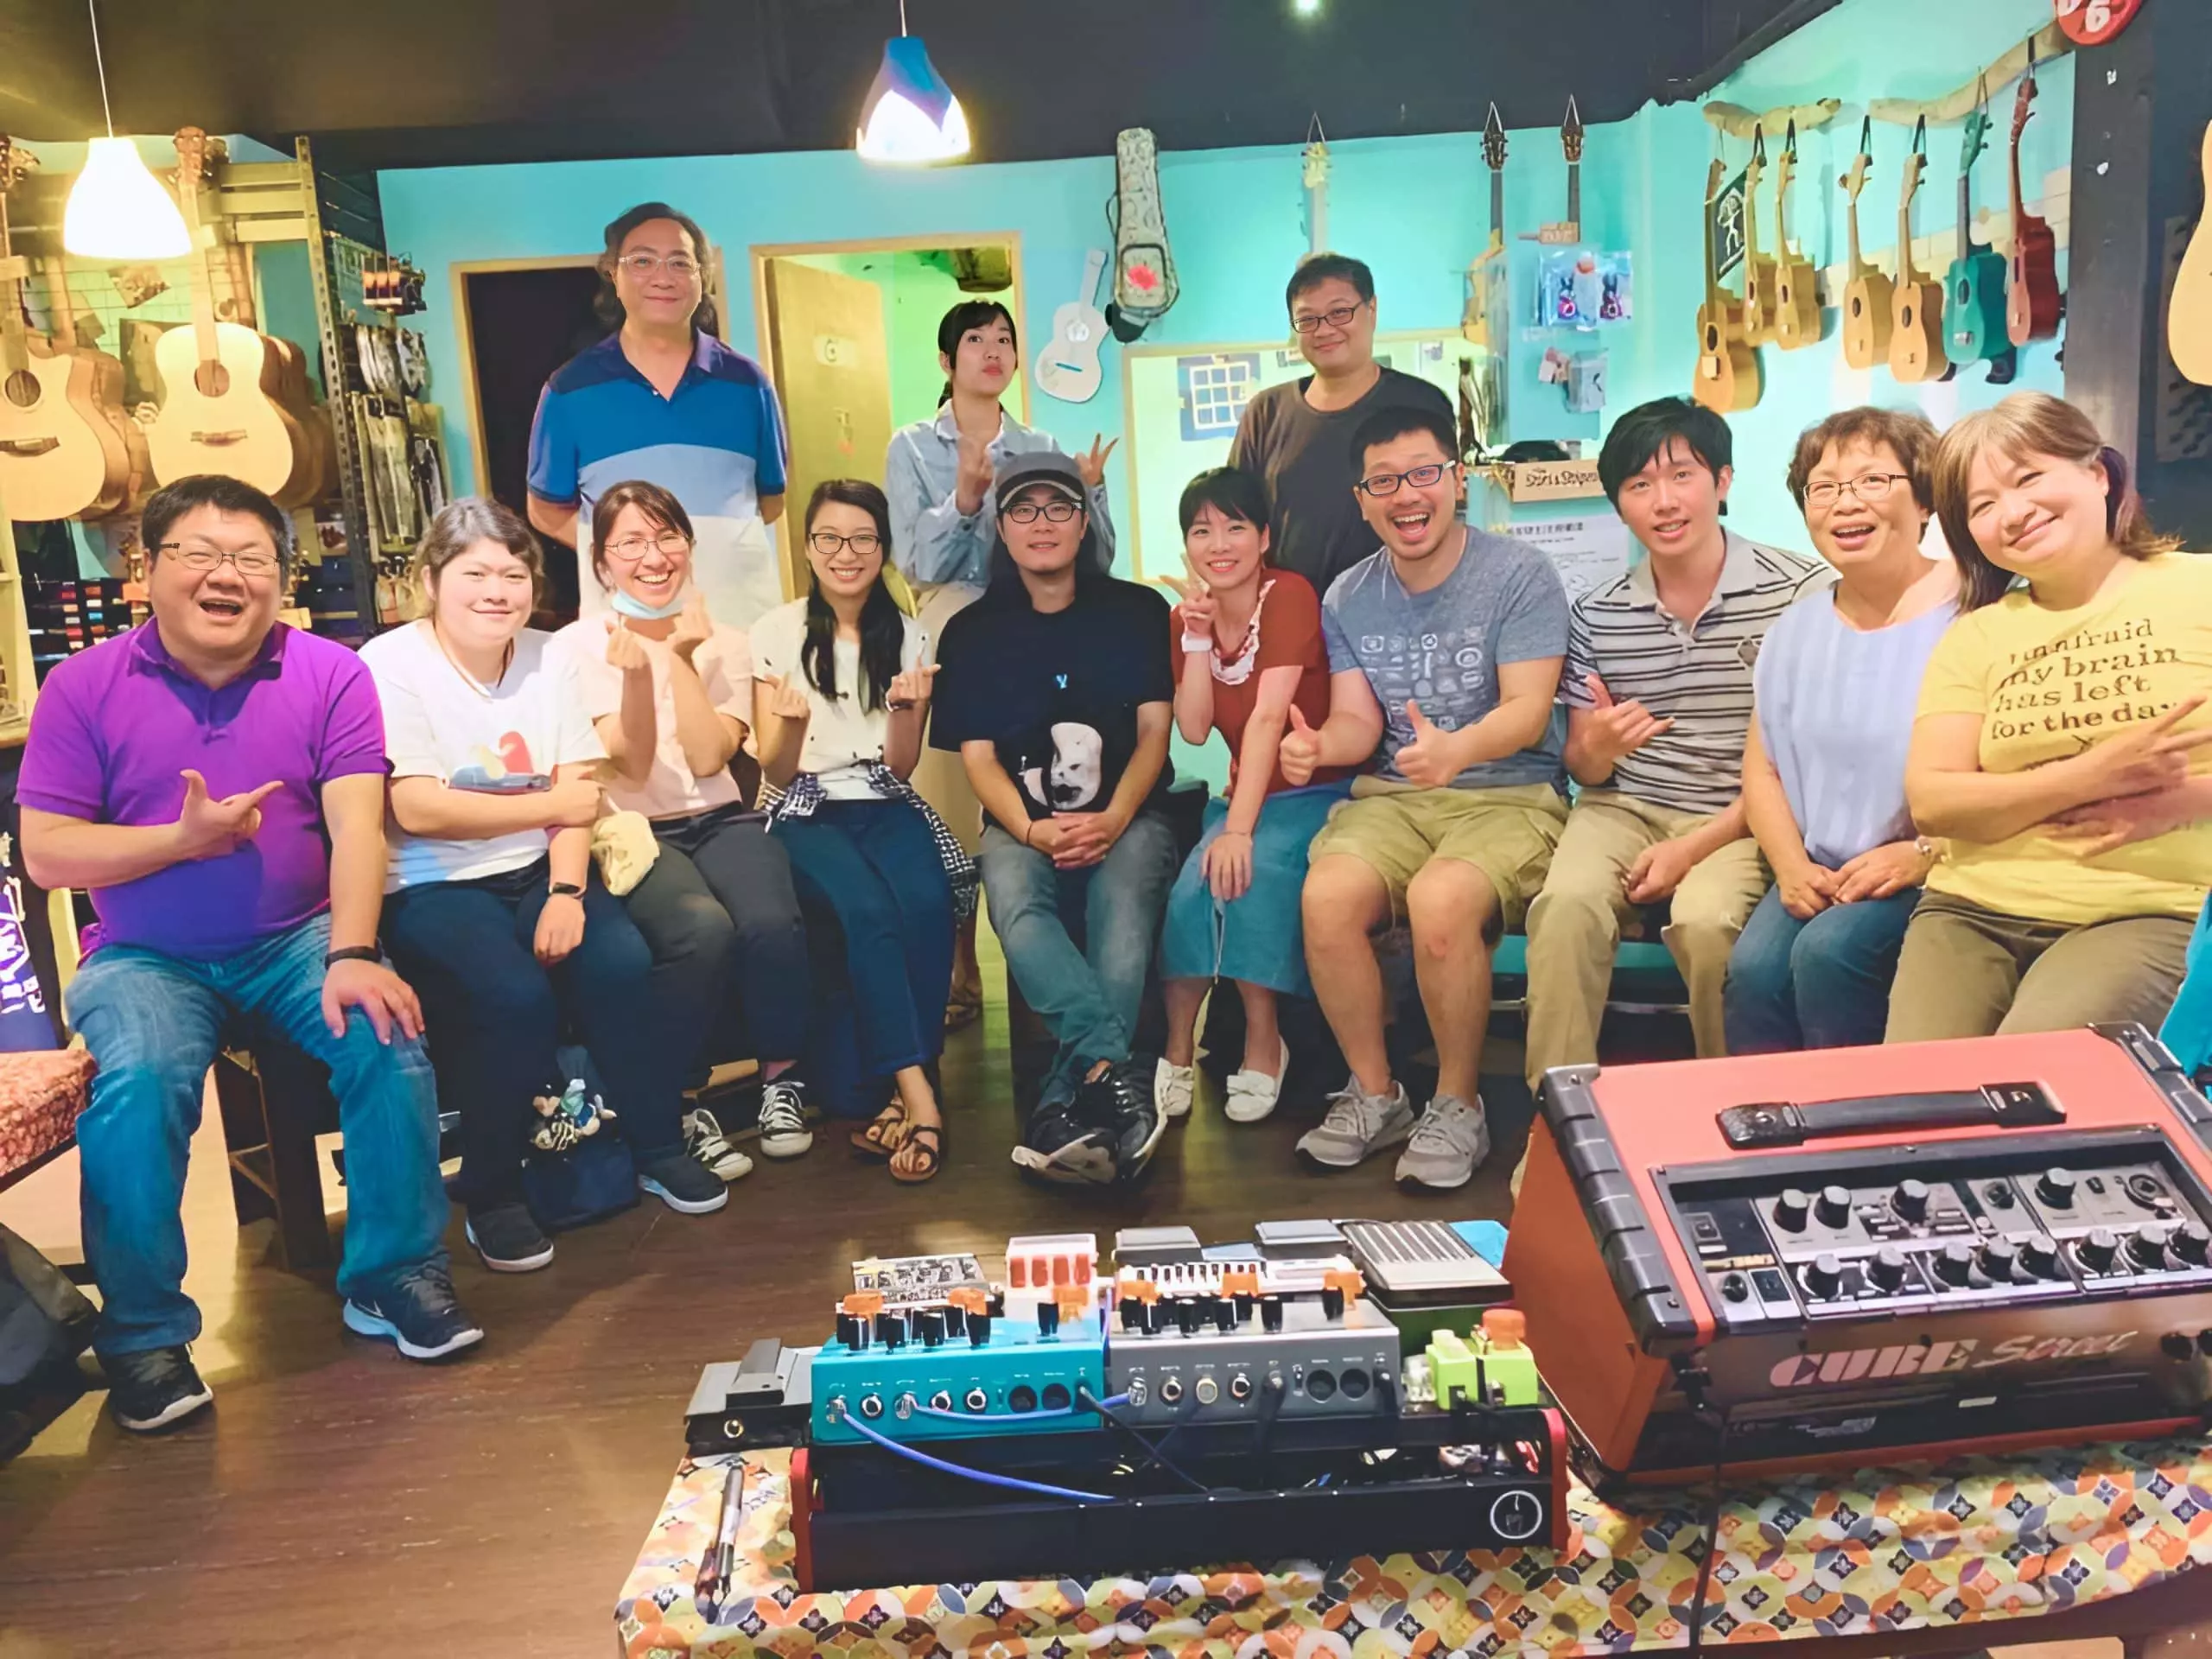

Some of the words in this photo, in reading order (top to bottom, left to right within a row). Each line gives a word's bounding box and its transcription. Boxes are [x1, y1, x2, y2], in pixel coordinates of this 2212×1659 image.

[1999, 665, 2054, 689] my
[2063, 643, 2180, 677] brain
[1995, 690, 2062, 713] has
[2074, 674, 2152, 703] left
[1991, 720, 2035, 741] for
[2043, 711, 2103, 731] the
[2112, 702, 2177, 723] da
